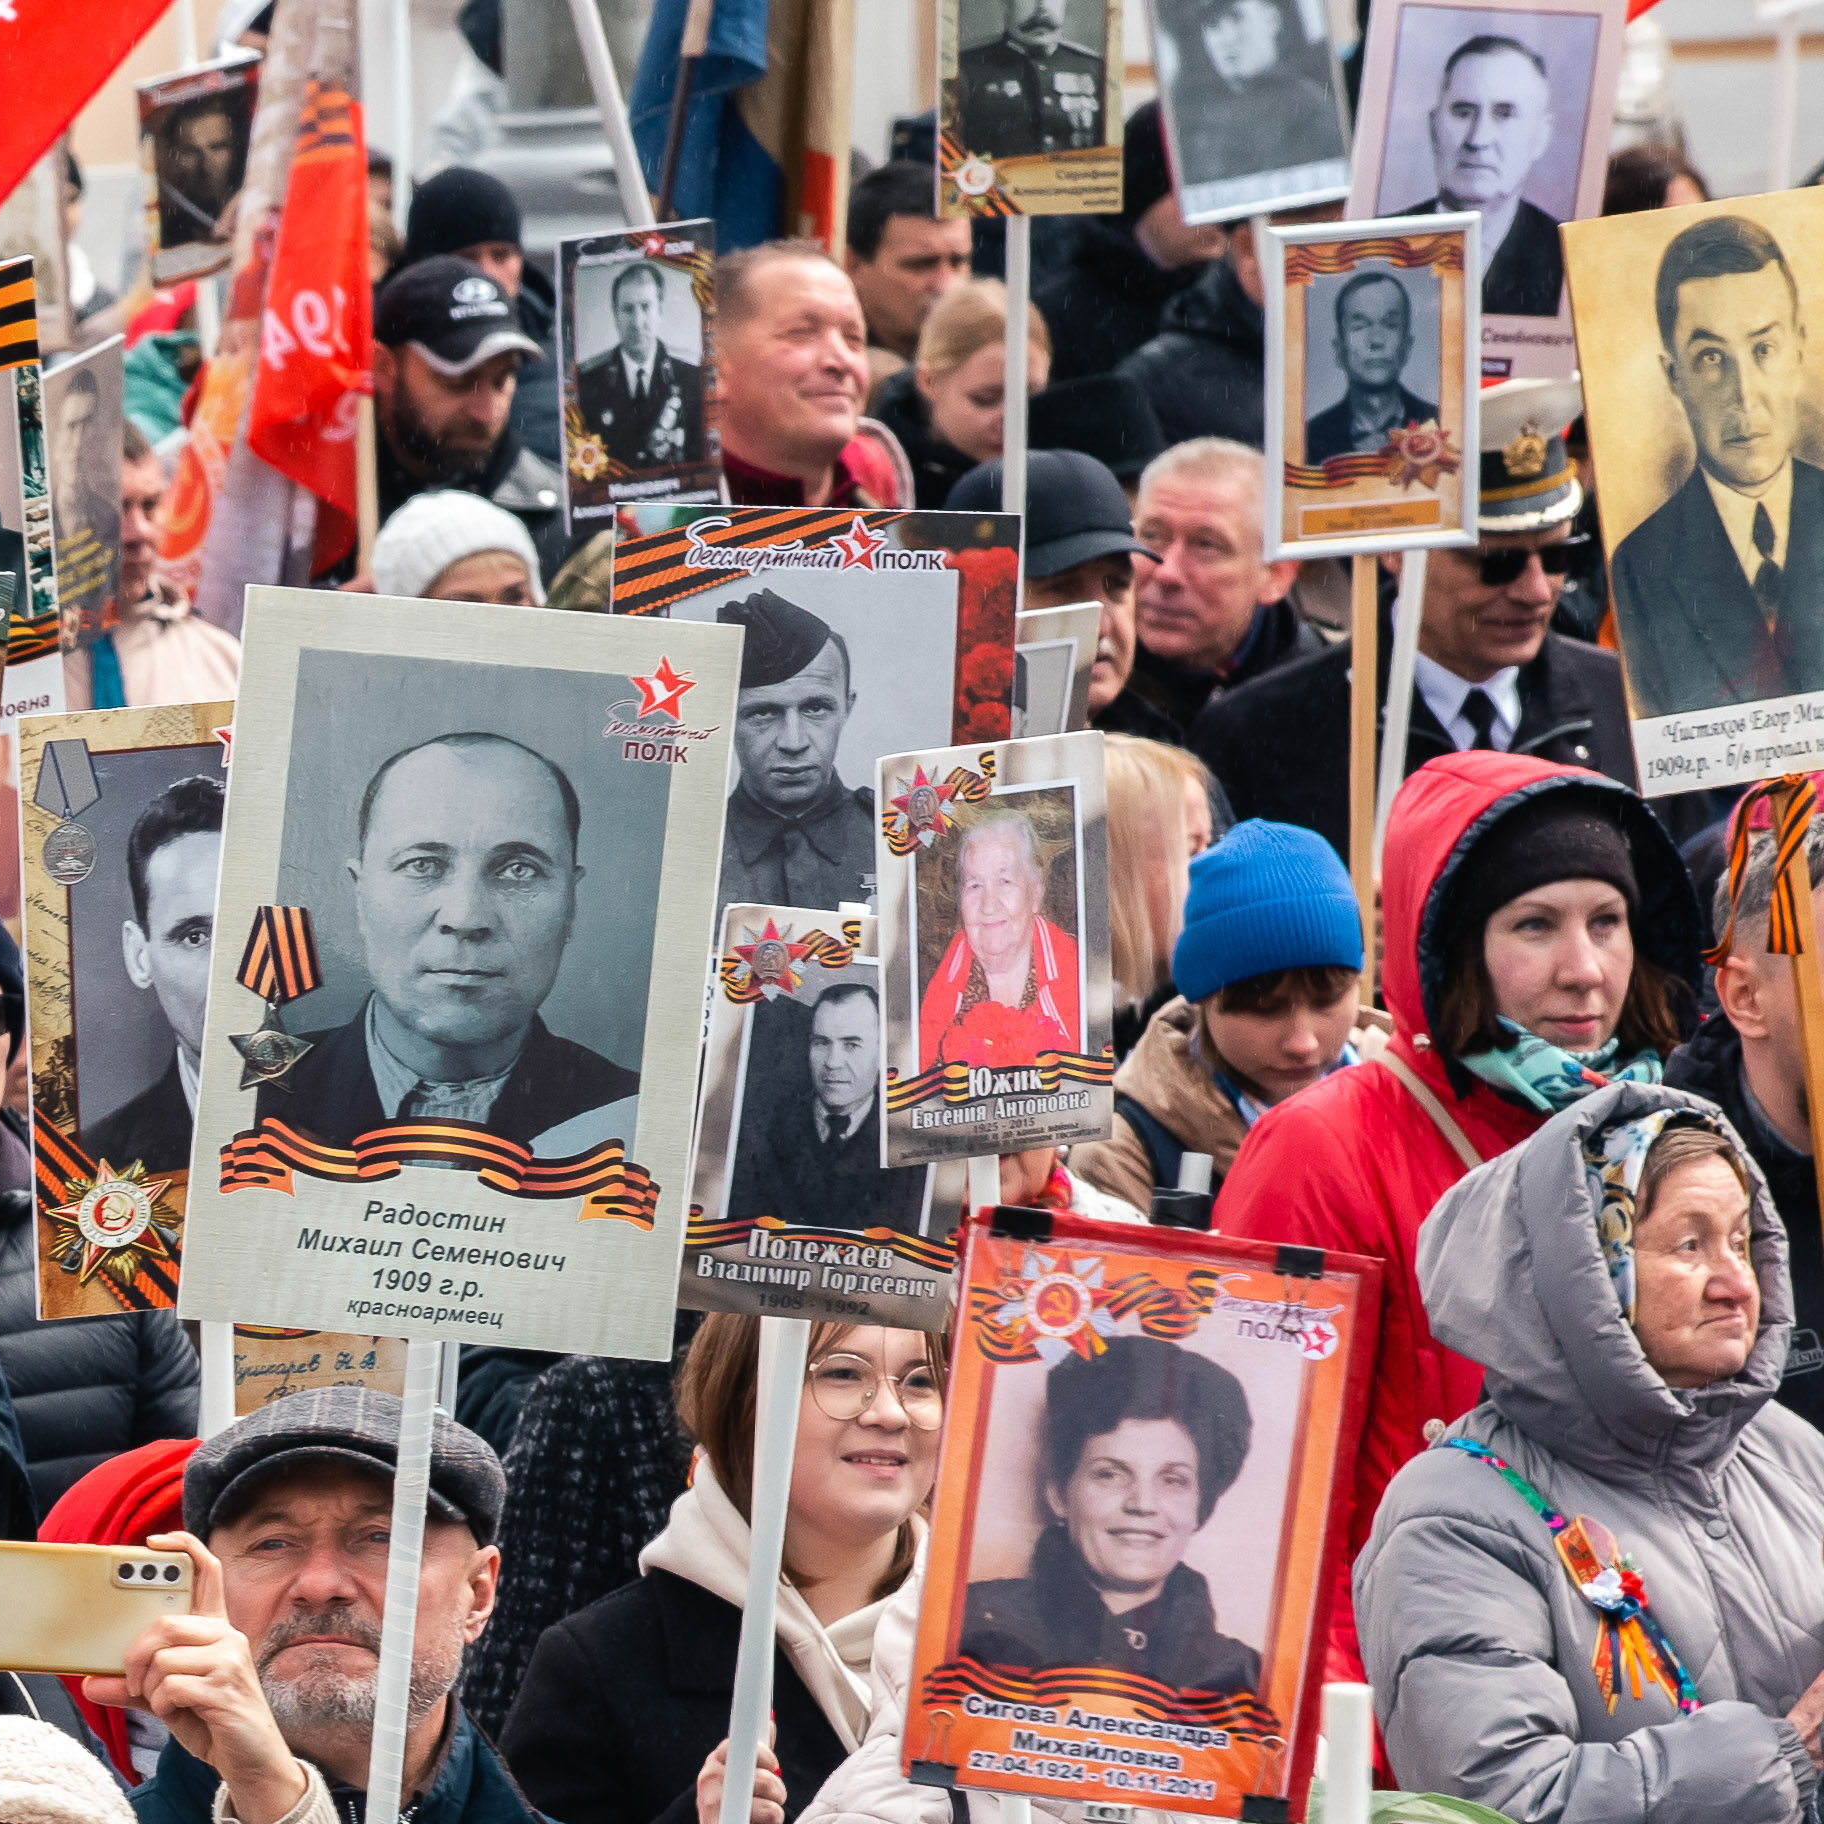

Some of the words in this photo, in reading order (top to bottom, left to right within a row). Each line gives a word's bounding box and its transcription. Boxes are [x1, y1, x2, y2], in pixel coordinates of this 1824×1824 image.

[1663, 717, 1747, 743] Чистяков
[1749, 709, 1792, 733] Егор
[969, 1066, 1043, 1098] Южик
[911, 1103, 987, 1131] Евгения
[993, 1090, 1091, 1121] Антоновна
[363, 1199, 507, 1234] Радостин
[297, 1228, 402, 1258] Михаил
[411, 1237, 566, 1272] Семенович
[747, 1229, 894, 1271] Полежаев
[371, 1268, 432, 1294] 1909
[439, 1278, 484, 1302] г.р.
[697, 1253, 812, 1292] Владимир
[821, 1266, 937, 1299] Гордеевич
[346, 1299, 505, 1330] красноармеец
[963, 1694, 1059, 1727] Сигова
[1065, 1705, 1229, 1750] Александра
[1012, 1730, 1181, 1772] Михайловна
[967, 1752, 1085, 1783] 27.04.1924
[1103, 1771, 1216, 1800] 10.11.2011
